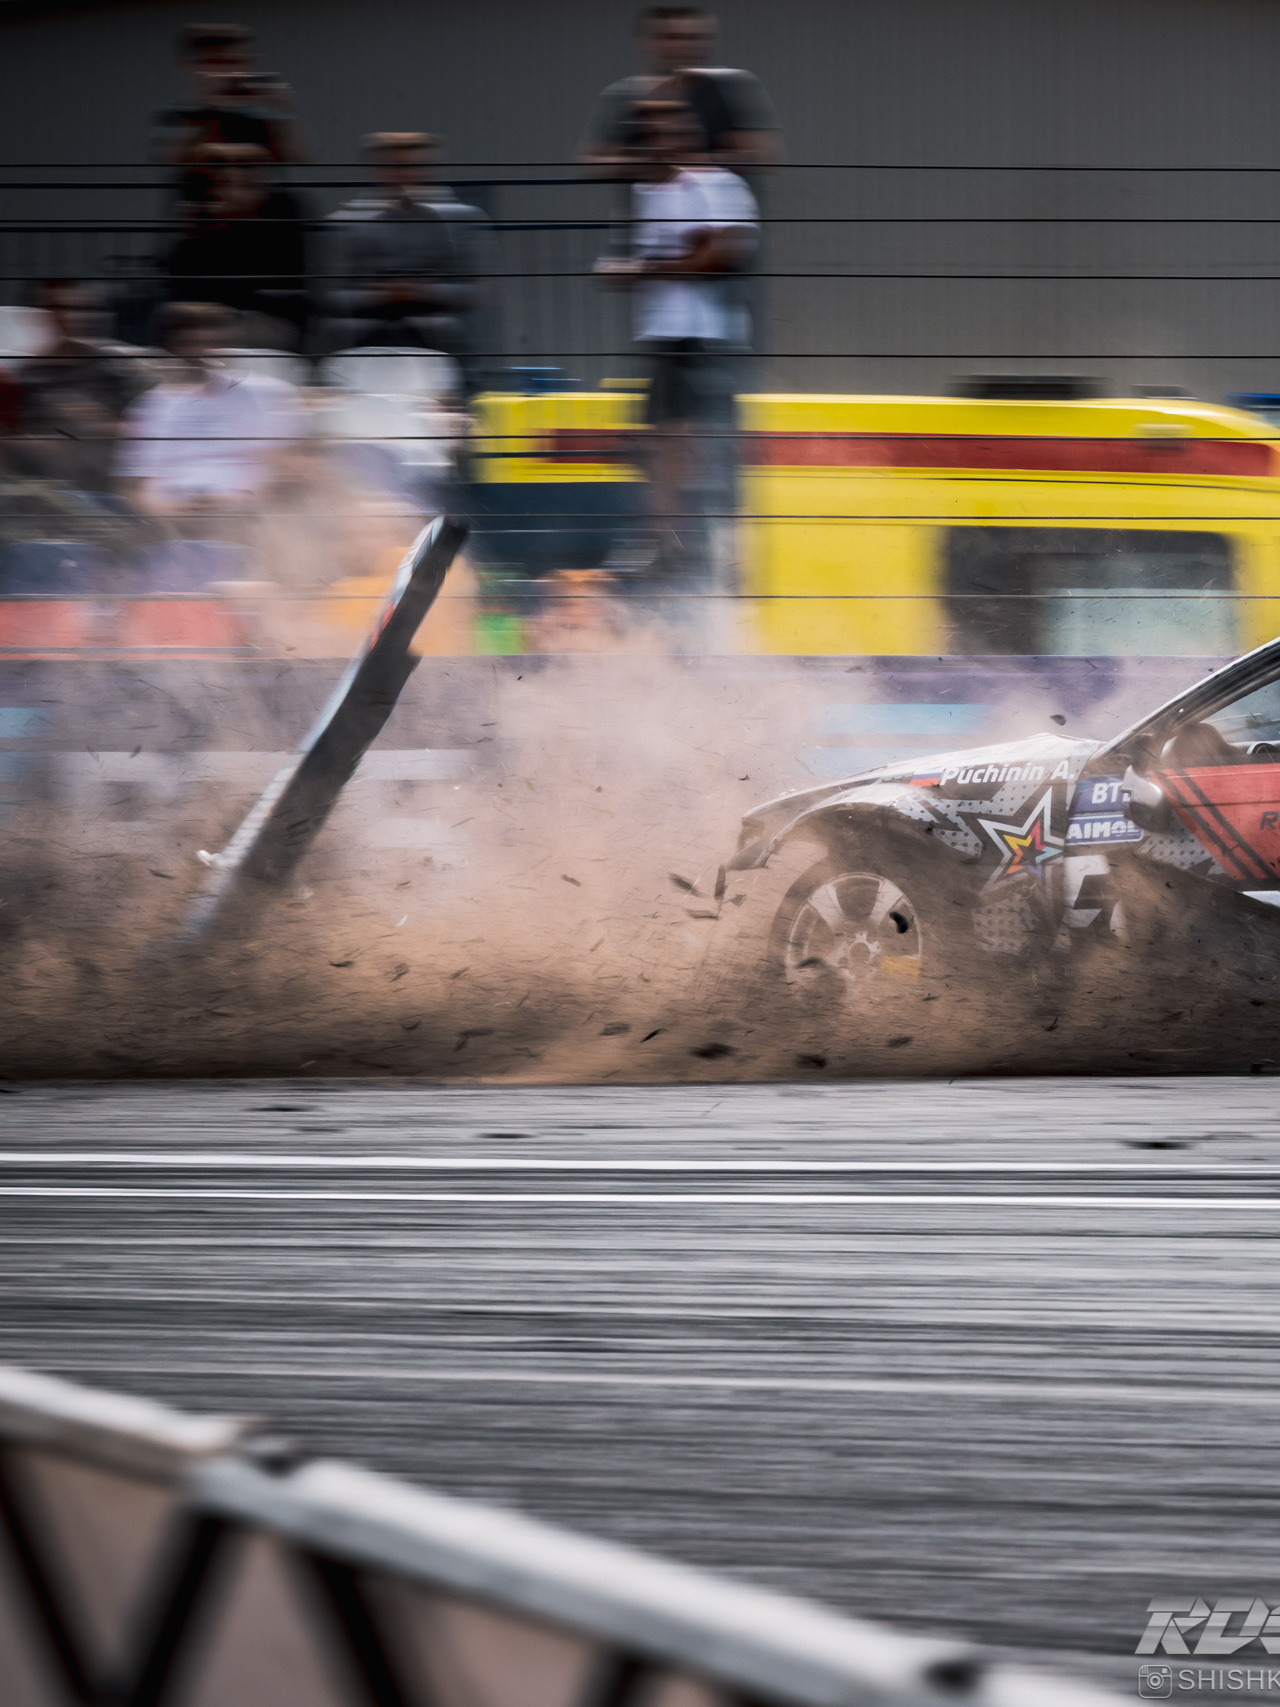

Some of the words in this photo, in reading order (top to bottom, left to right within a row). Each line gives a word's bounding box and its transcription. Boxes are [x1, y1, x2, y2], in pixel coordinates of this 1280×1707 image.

[939, 763, 1045, 786] Puchinin
[1050, 760, 1075, 780] A.
[1066, 821, 1141, 840] AIMOL
